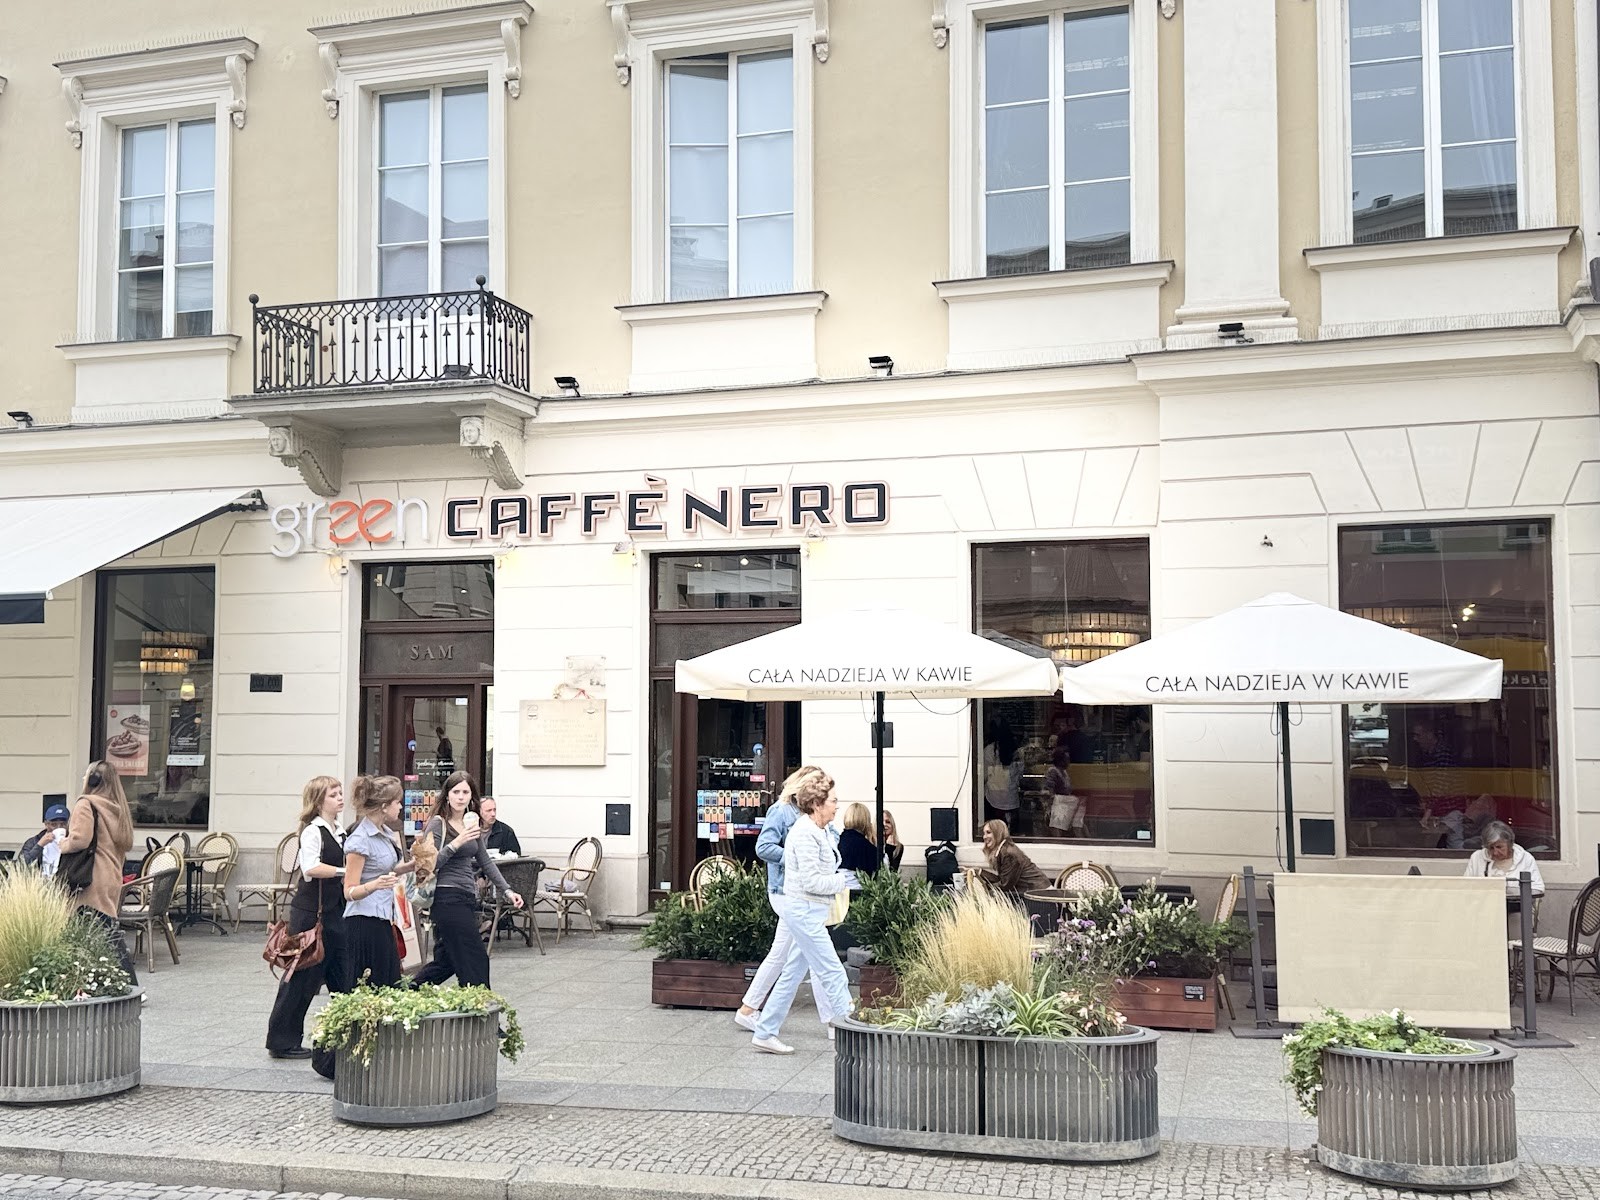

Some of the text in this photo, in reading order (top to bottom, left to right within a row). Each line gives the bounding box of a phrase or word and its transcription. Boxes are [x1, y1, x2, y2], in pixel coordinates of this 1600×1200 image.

[446, 474, 890, 540] CAFFÈ NERO
[271, 497, 430, 558] green
[410, 645, 454, 660] SAM
[748, 666, 972, 683] CAŁA NADZIEJA W KAWIE
[1145, 672, 1409, 692] CAŁA NADZIEJA W KAWIE
